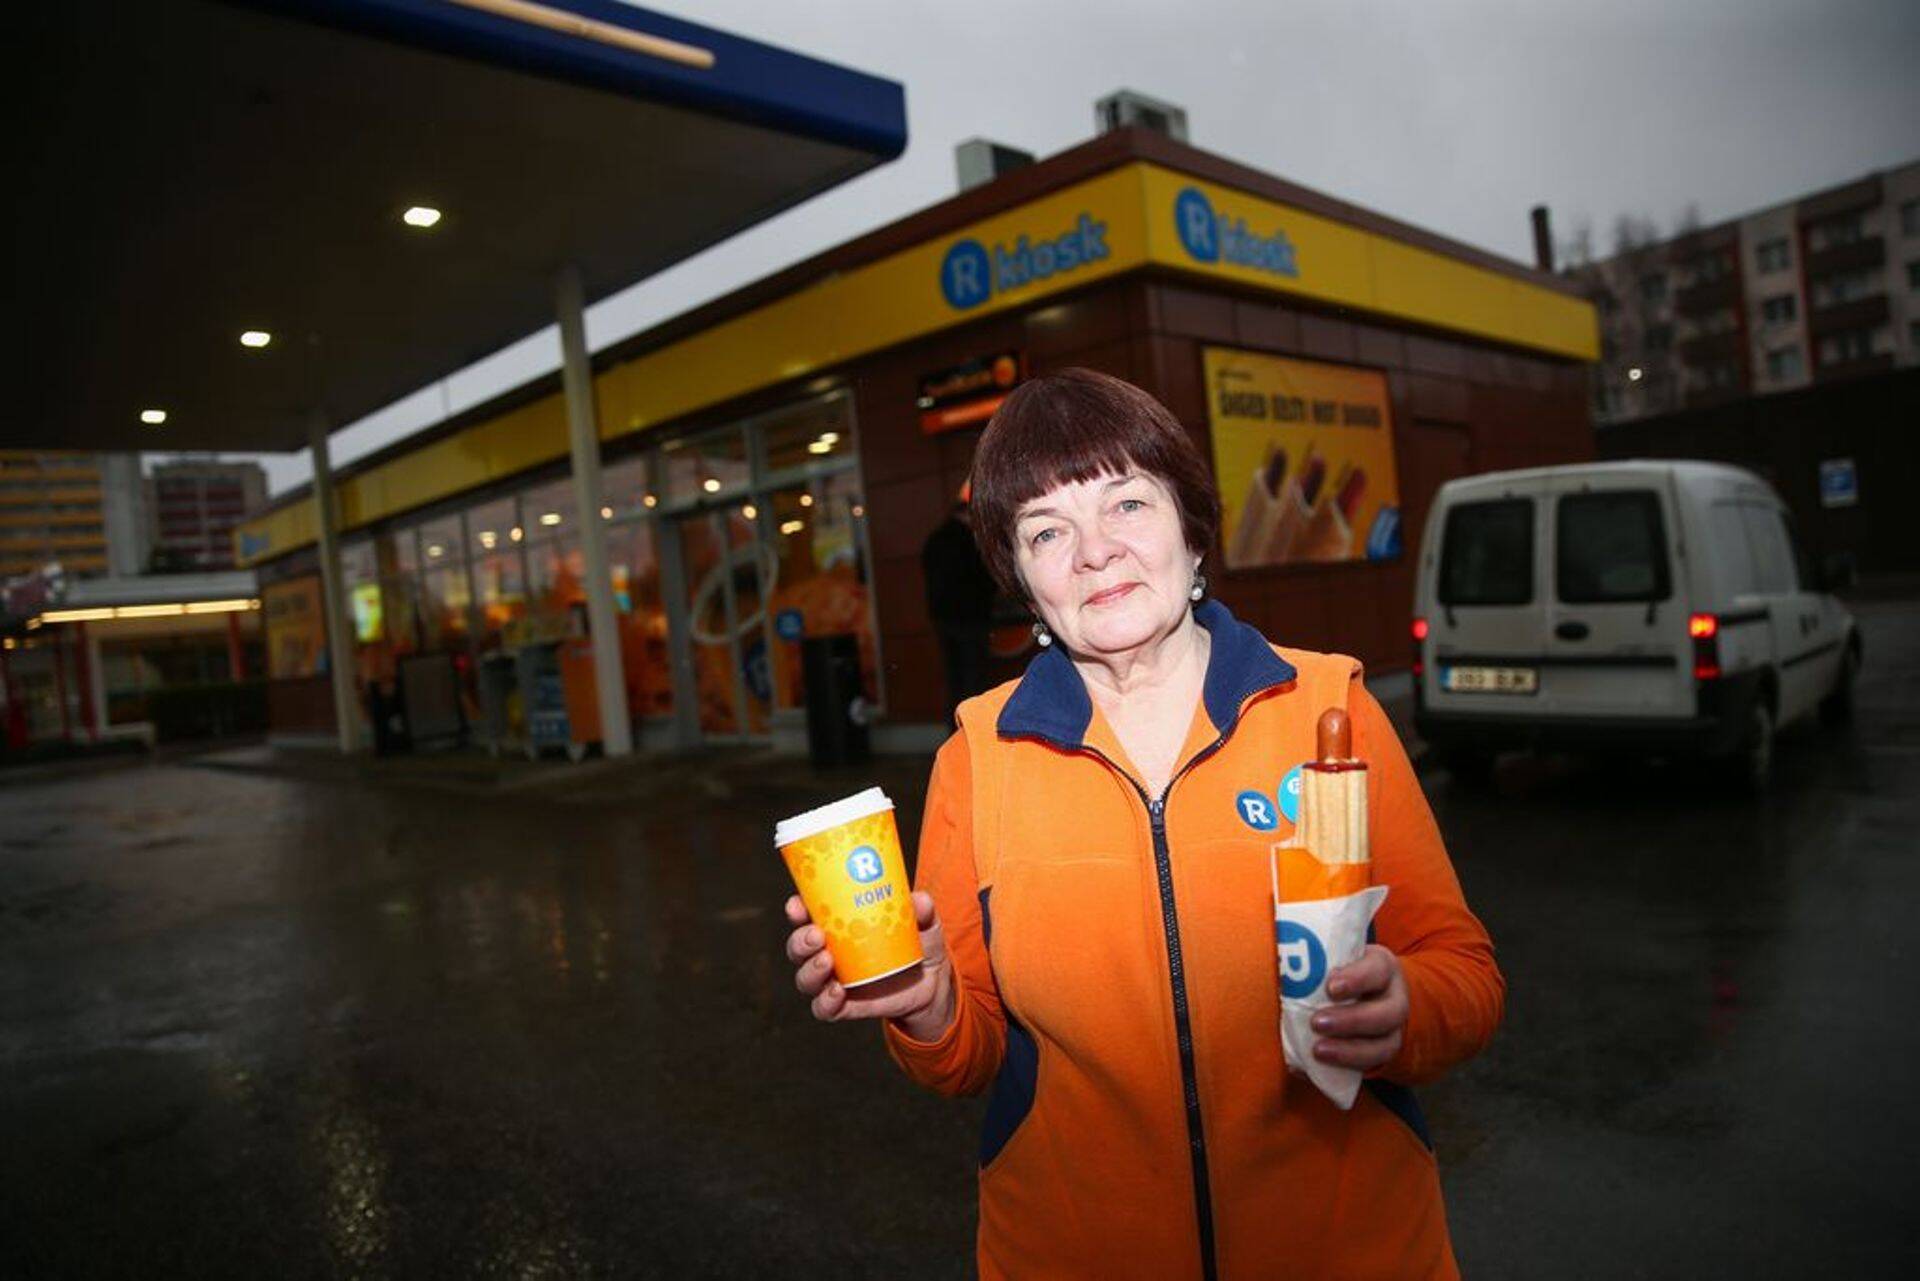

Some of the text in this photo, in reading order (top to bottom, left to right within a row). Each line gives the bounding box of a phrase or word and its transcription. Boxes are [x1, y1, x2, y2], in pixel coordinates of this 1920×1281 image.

[996, 212, 1109, 292] kiosk
[1217, 213, 1299, 278] kiosk
[1242, 798, 1272, 824] R
[854, 884, 892, 908] KOHV
